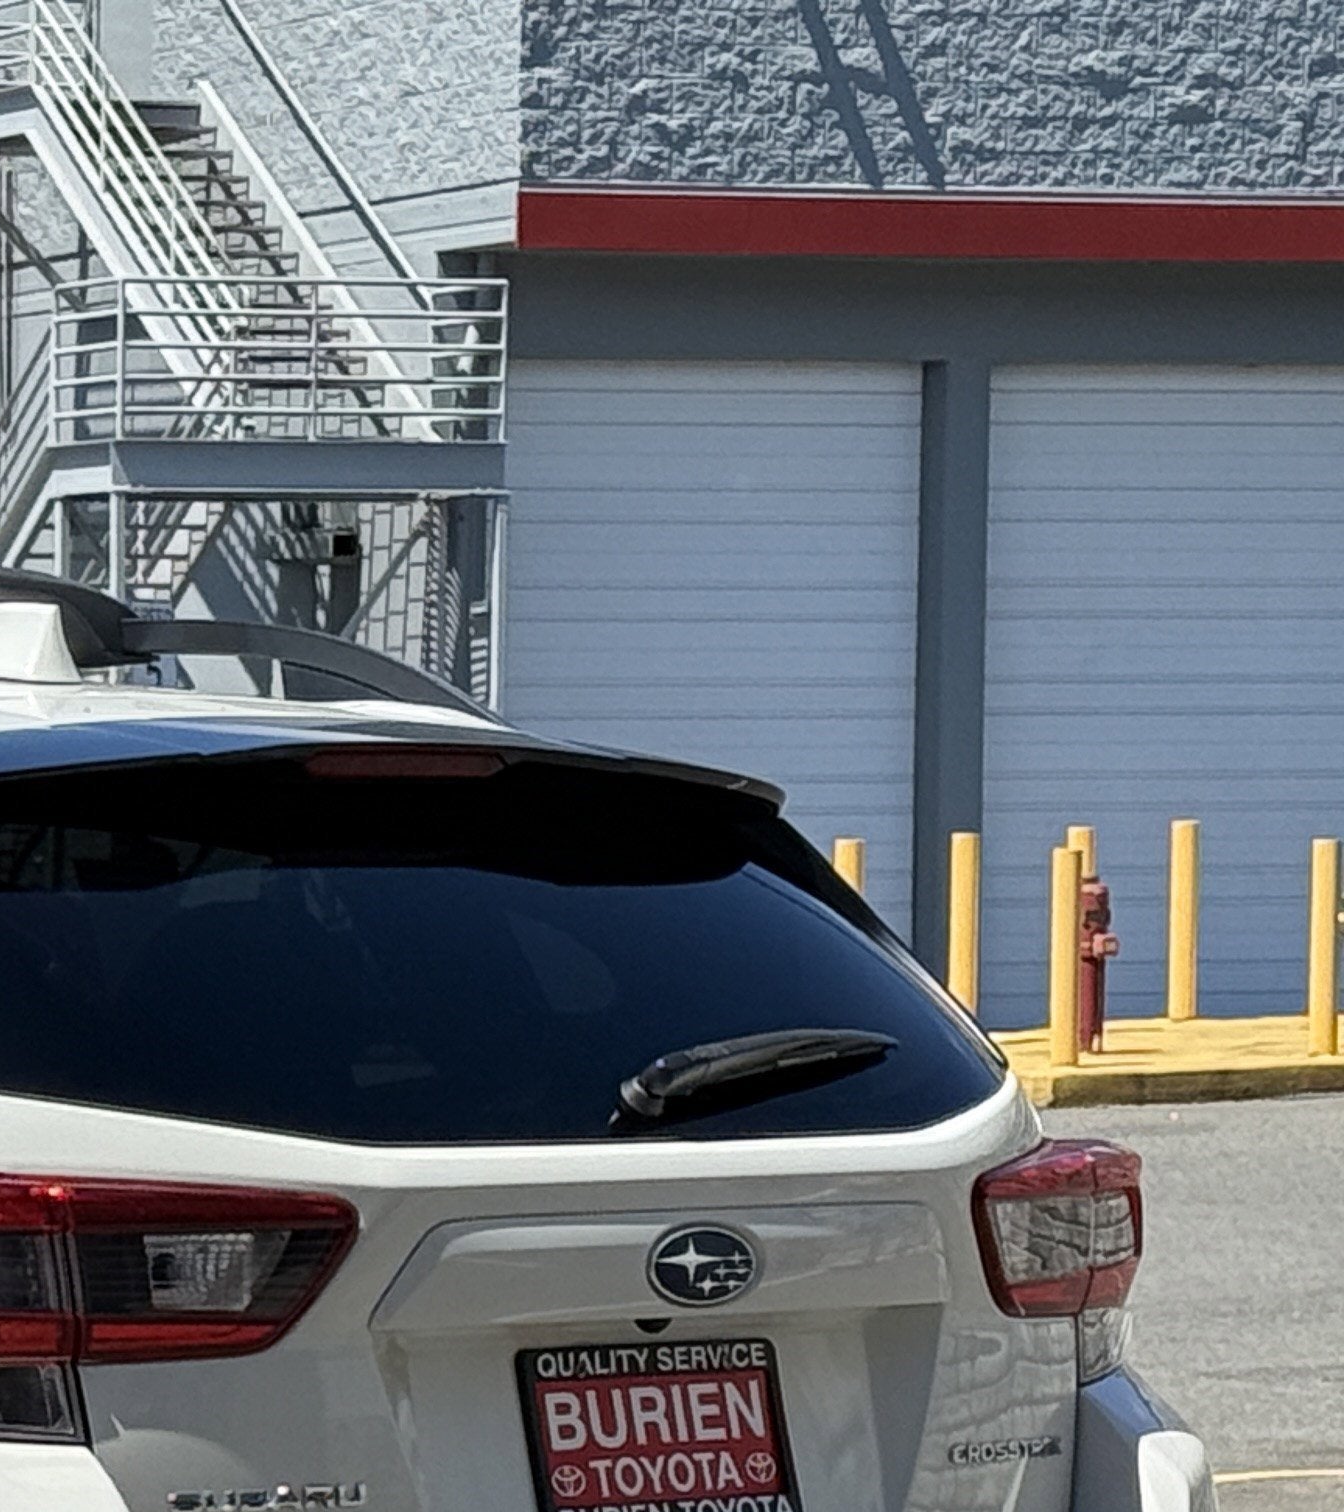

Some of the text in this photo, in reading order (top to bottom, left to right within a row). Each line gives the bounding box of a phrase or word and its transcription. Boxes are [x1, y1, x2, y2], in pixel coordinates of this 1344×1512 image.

[536, 1342, 768, 1379] QUALITY SERVICE
[544, 1379, 766, 1451] BURIEN
[948, 1436, 1062, 1465] CROSSTR
[588, 1450, 746, 1499] TOYOTA
